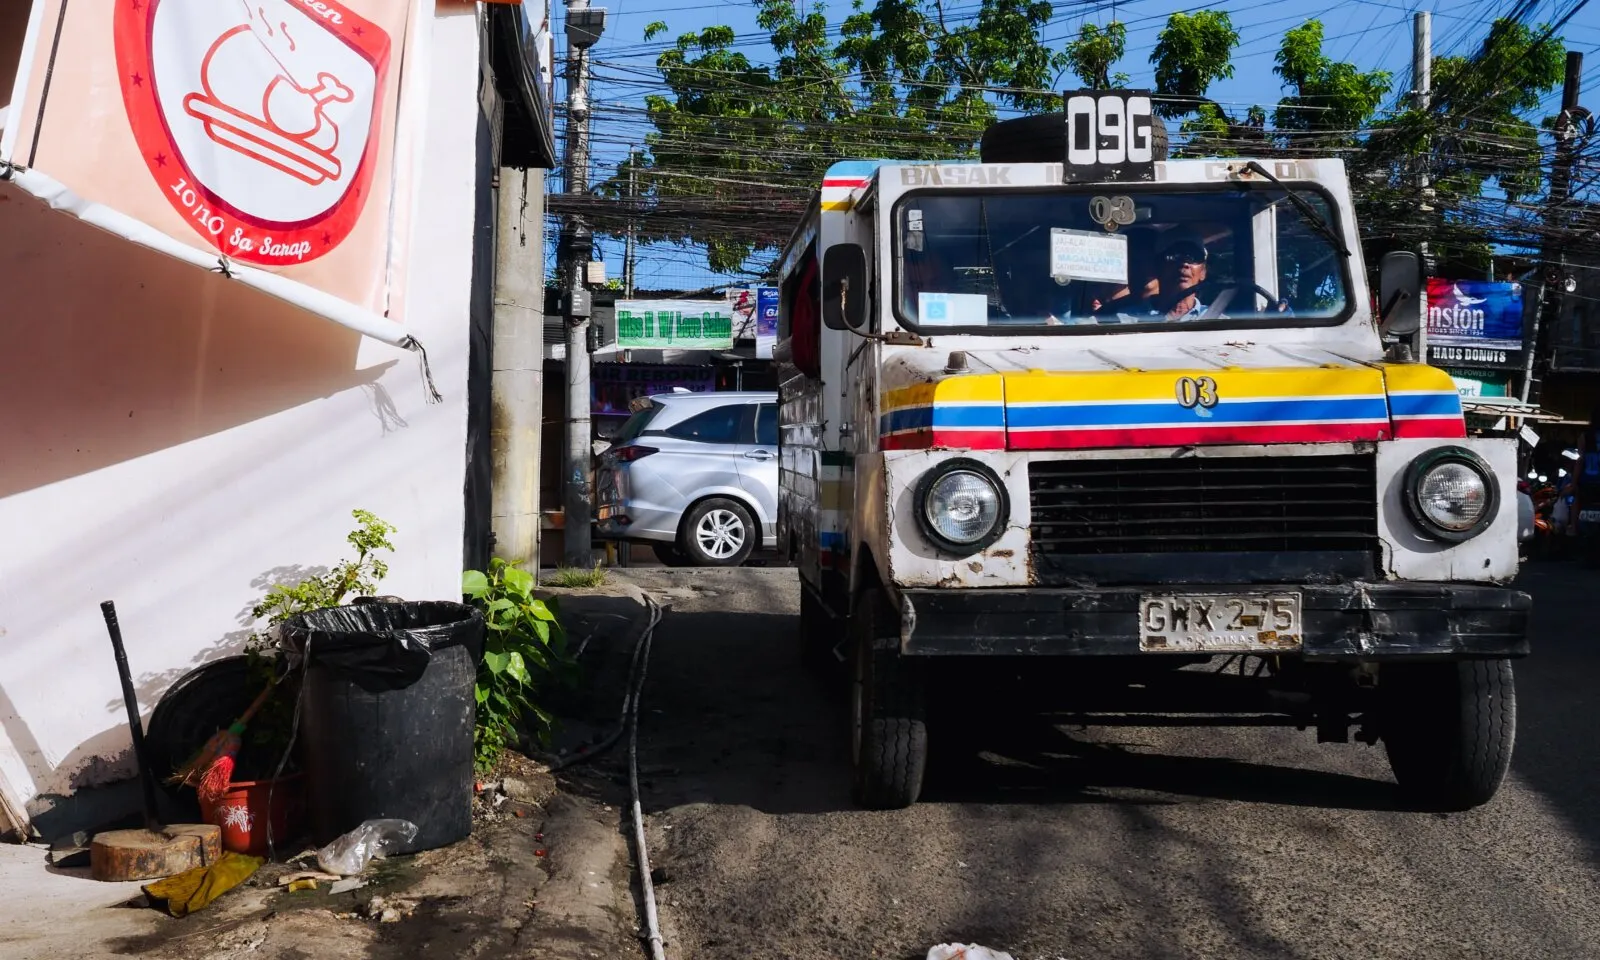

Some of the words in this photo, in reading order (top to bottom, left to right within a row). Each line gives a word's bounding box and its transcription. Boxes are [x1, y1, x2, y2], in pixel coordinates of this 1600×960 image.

[900, 165, 1012, 186] BASAK
[170, 177, 225, 235] 10/10
[229, 227, 253, 251] Sa
[258, 236, 312, 260] Sarap
[1427, 304, 1484, 330] nston
[1433, 346, 1462, 360] HAUS
[1464, 348, 1506, 362] DONUTS
[1463, 369, 1487, 377] POWER
[1175, 375, 1219, 409] 03
[1144, 599, 1216, 633] GWX
[1224, 599, 1296, 632] 275
